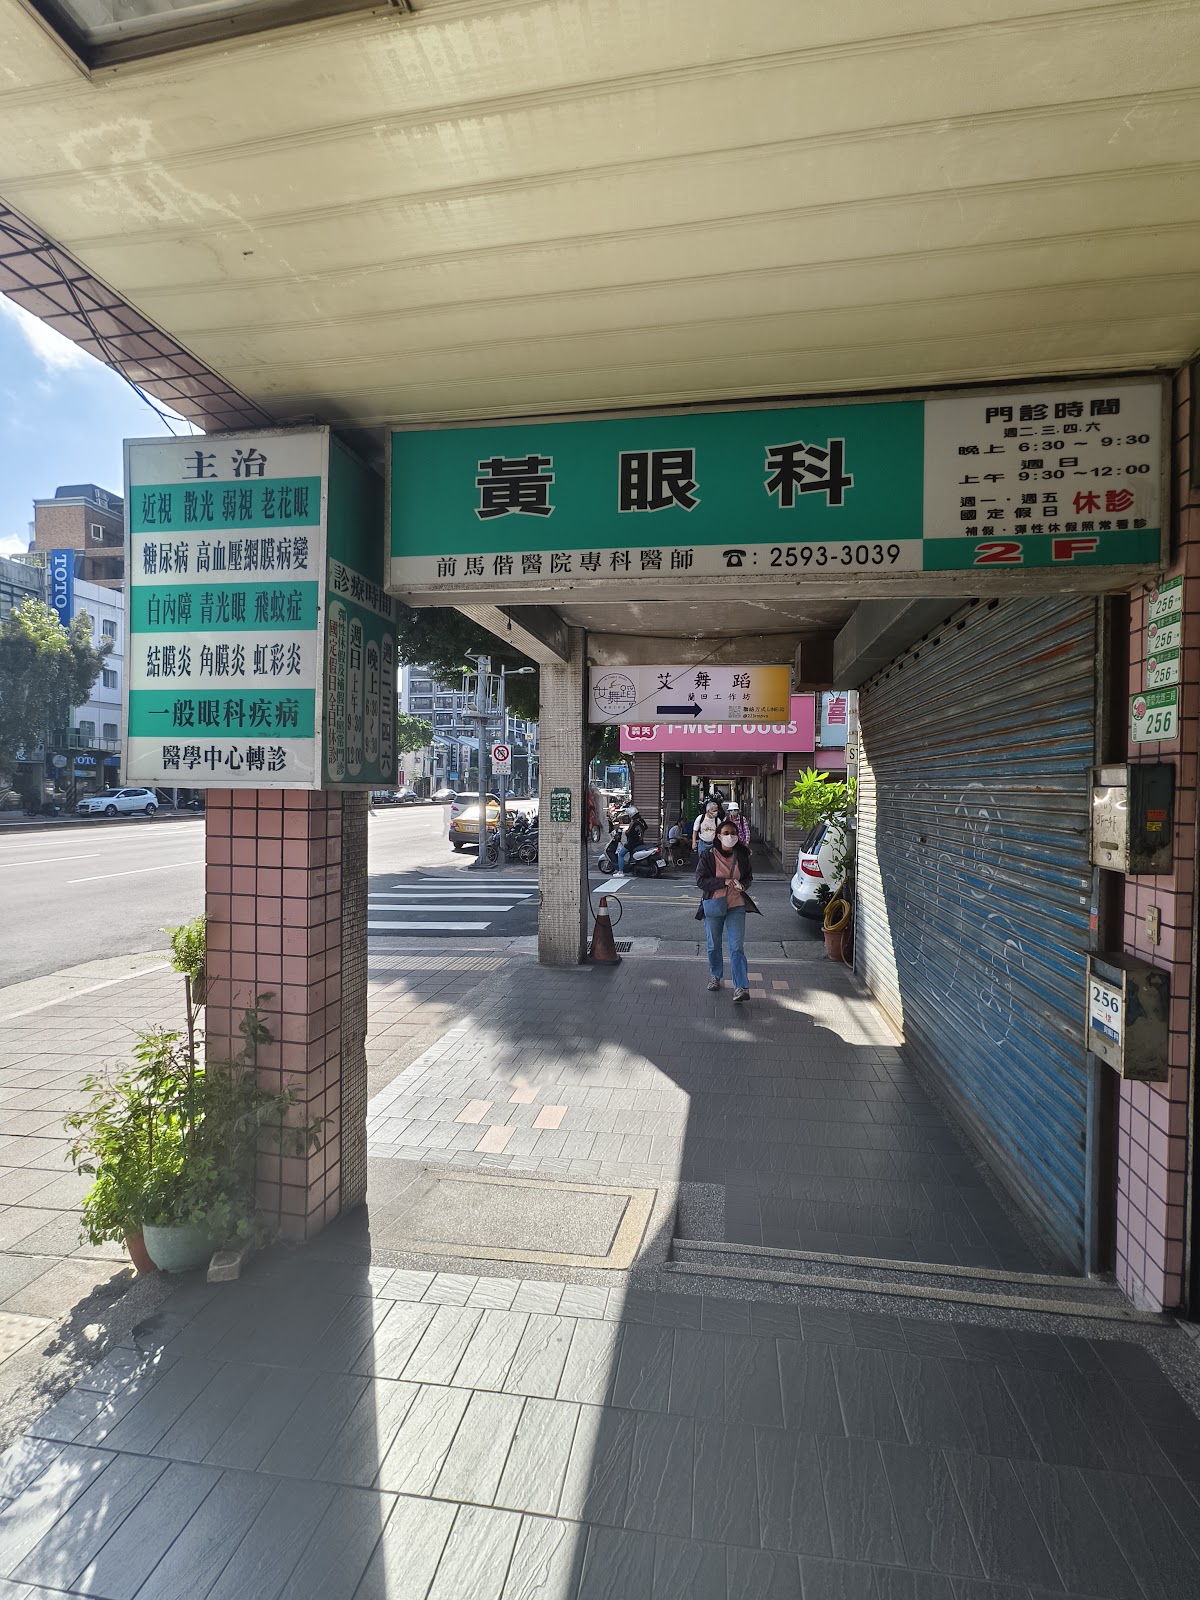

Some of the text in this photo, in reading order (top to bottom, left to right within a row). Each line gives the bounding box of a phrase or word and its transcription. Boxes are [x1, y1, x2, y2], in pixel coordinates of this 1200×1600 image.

[985, 398, 1121, 424] 門診時間
[958, 444, 1006, 456] 晚上
[1018, 440, 1065, 452] 6:30
[1101, 434, 1151, 447] 9:30
[182, 448, 268, 480] 主治
[958, 473, 1006, 485] 上午
[1018, 469, 1065, 482] 9:30
[1020, 457, 1079, 470] 週日
[474, 436, 856, 522] 黃眼科
[142, 486, 309, 525] 近視 散光 弱視 老花眼
[960, 506, 1059, 521] 國定假日
[1073, 488, 1135, 515] 休診
[143, 536, 309, 575] 糖尿病 高血壓網膜病變
[436, 547, 695, 578] 前馬偕醫院專科醫師
[769, 543, 902, 568] 2593-3039
[55, 554, 67, 609] TOTO
[334, 563, 392, 617] 診療時間
[148, 589, 303, 625] 白內障 青光眼 飛蚊症
[1156, 595, 1174, 614] 256
[350, 624, 362, 670] 週日
[1155, 631, 1173, 649] 256
[146, 642, 302, 677] 結膜炎 角膜炎 虹彩炎
[367, 648, 378, 695] 晚上
[657, 671, 751, 691] 艾舞蹈
[1153, 667, 1171, 683] 256
[148, 697, 300, 728] 一般眼科疾病
[1146, 711, 1172, 735] 256
[73, 756, 97, 765] OTO
[162, 745, 287, 772] 醫學中心轉診
[1093, 986, 1119, 1013] 256
